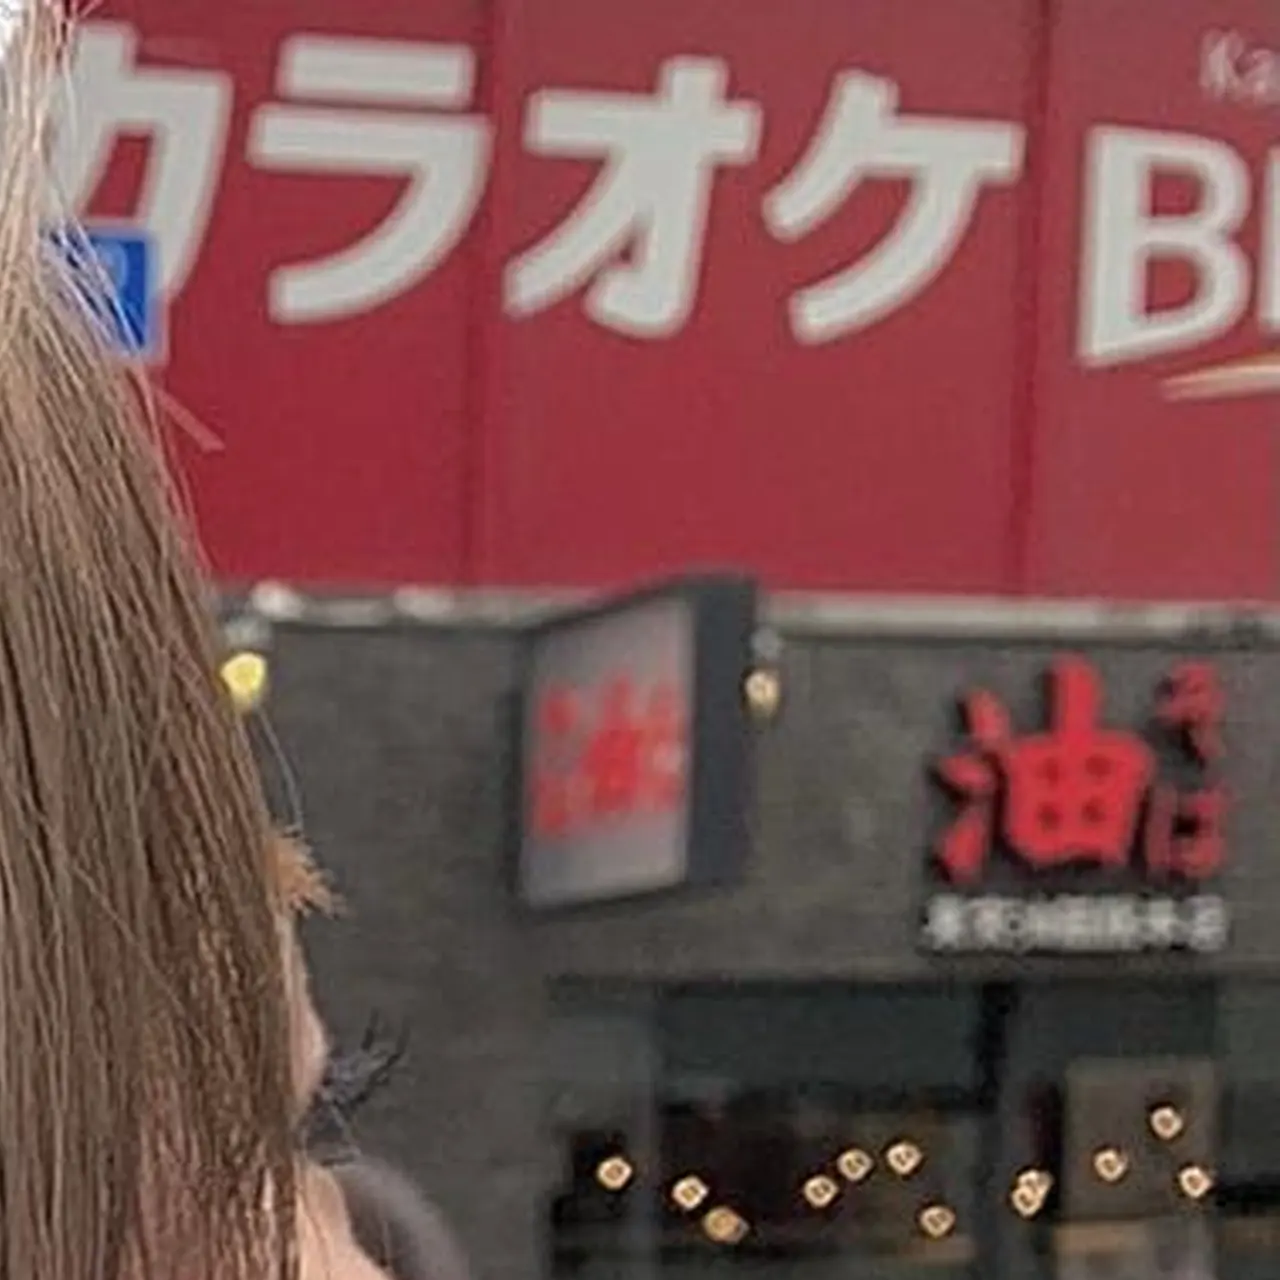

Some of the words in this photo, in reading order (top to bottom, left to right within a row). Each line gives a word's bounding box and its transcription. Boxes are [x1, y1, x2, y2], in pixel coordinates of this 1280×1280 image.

[25, 18, 1027, 345] カラオケ
[935, 648, 1154, 884] 油
